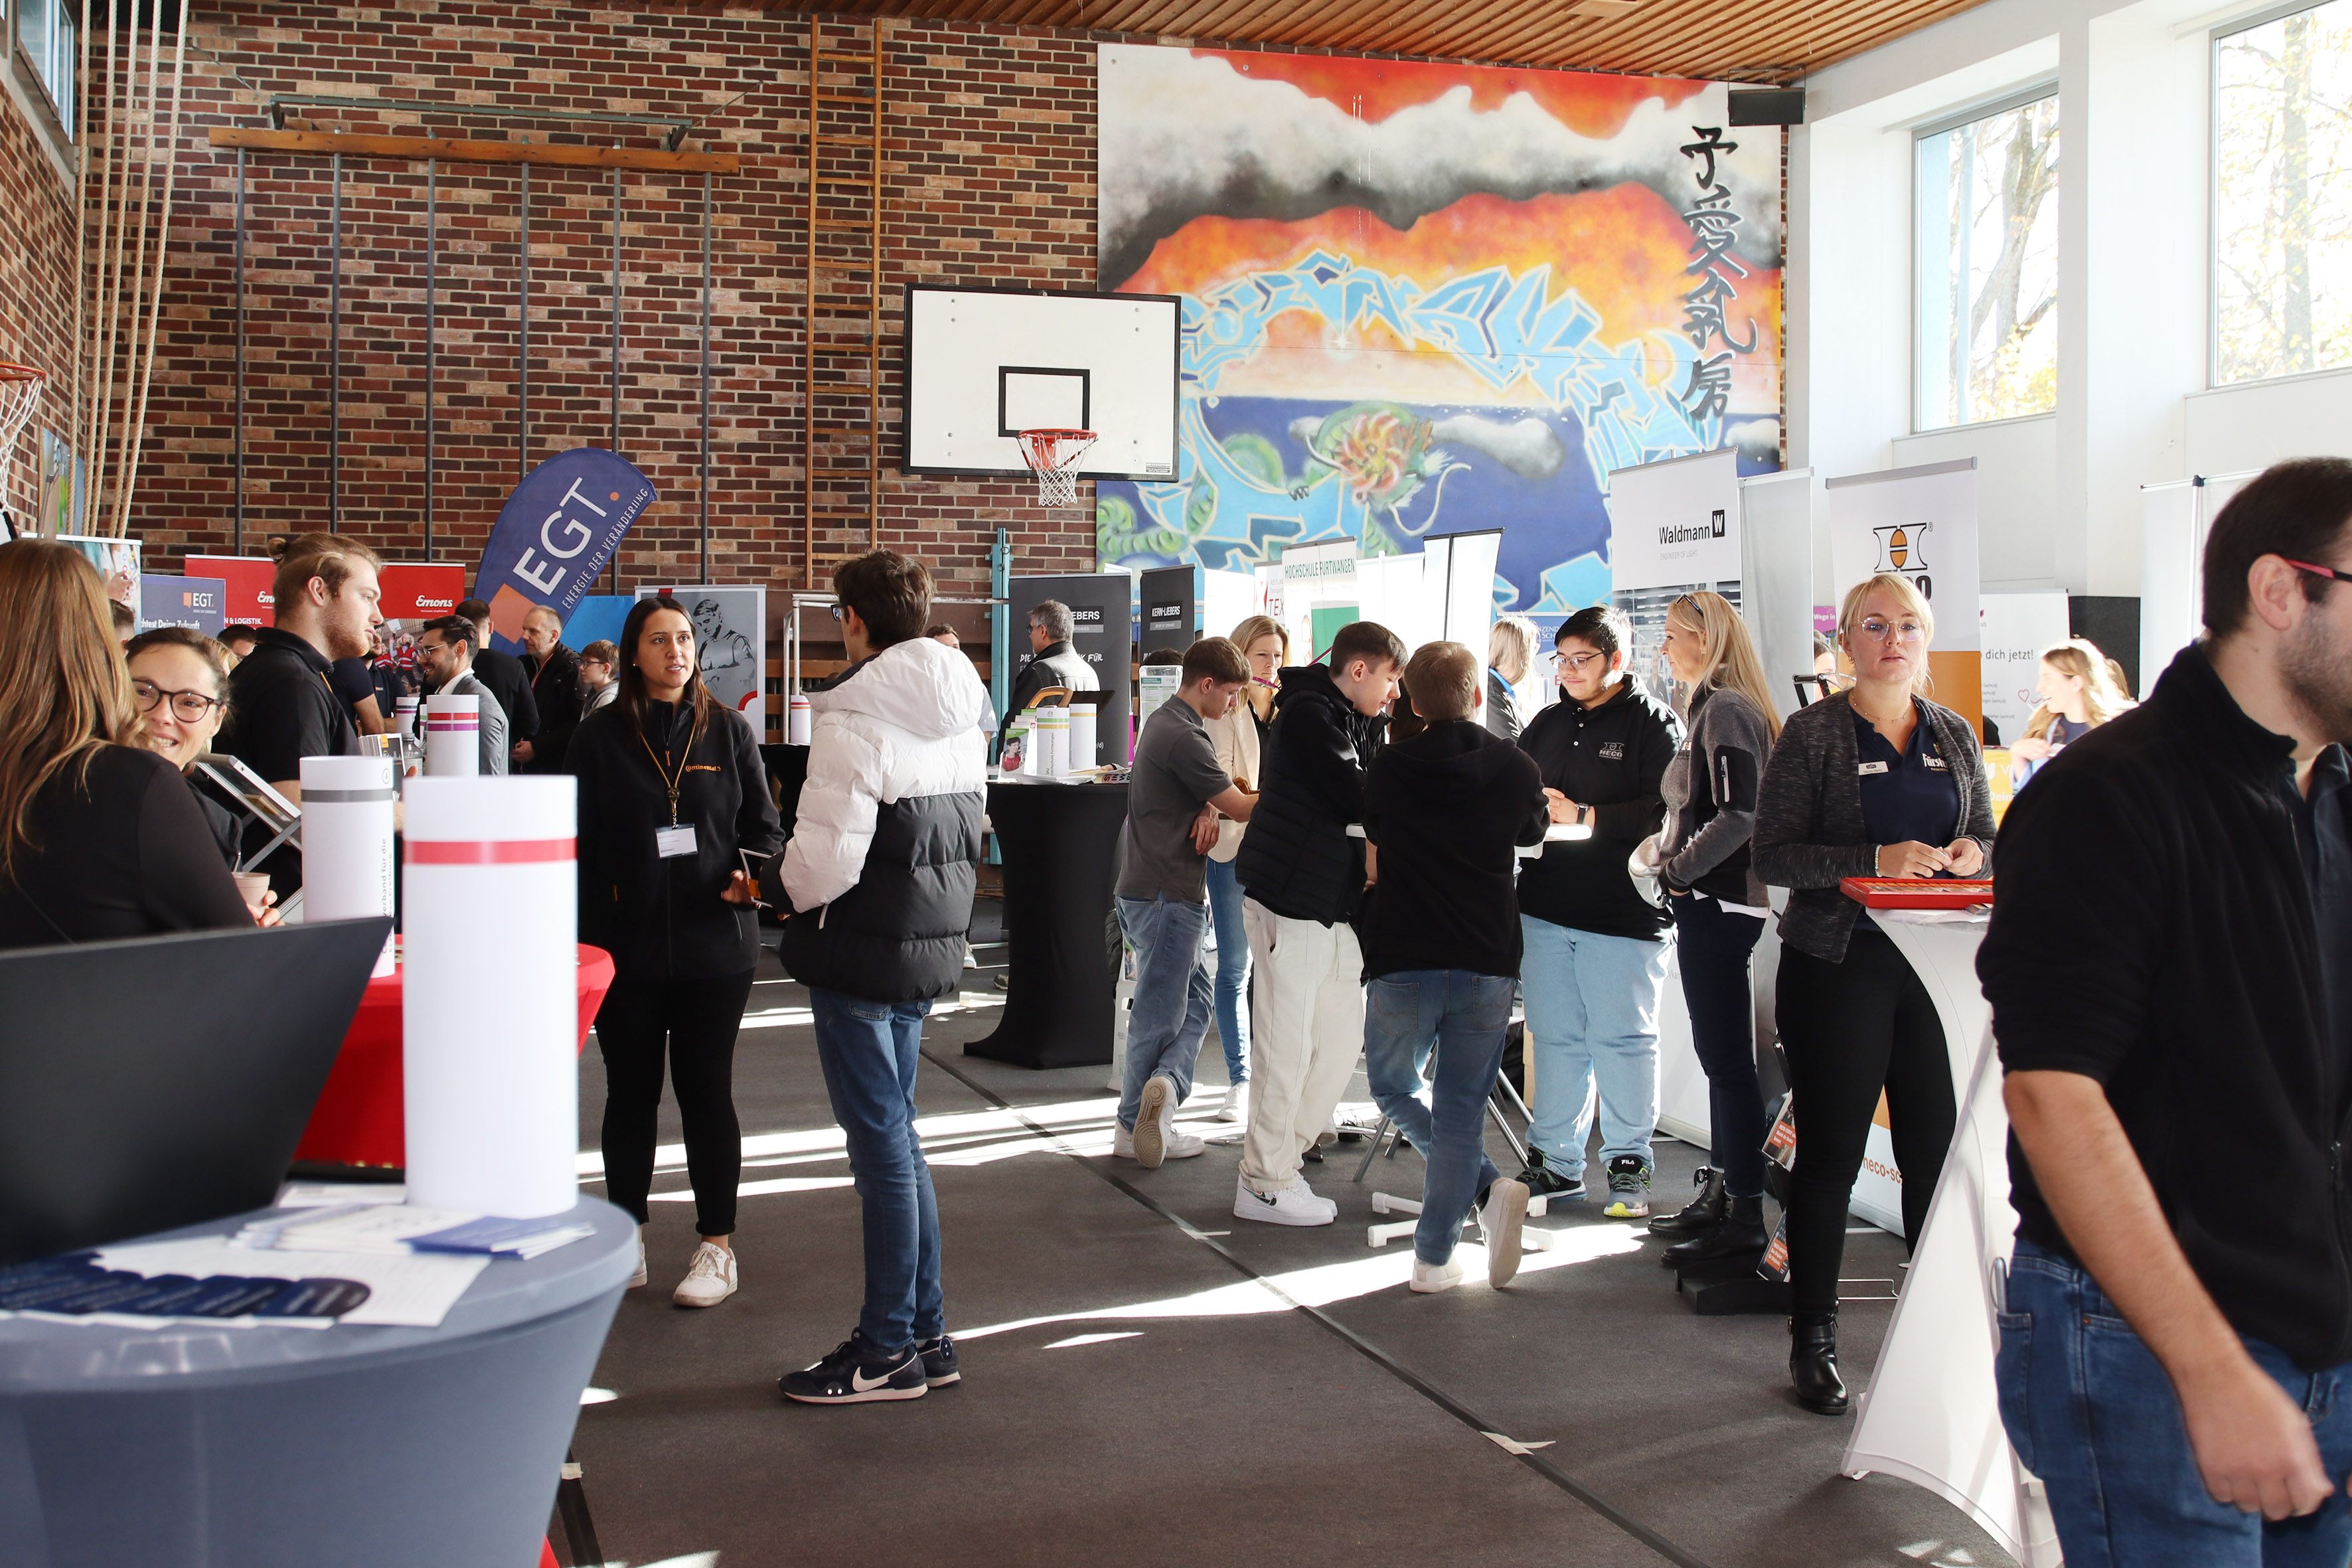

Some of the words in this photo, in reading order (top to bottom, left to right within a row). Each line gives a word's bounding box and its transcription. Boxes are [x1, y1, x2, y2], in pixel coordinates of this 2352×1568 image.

[1659, 524, 1710, 544] Waldmann
[1713, 514, 1724, 534] W
[1660, 552, 1680, 561] ENGINEER
[1285, 562, 1318, 579] HOCHSCHULE
[1319, 558, 1355, 576] FURTWANGEN
[562, 570, 592, 609] ENERGIE
[588, 552, 605, 571] DER
[257, 590, 275, 603] Em
[415, 595, 453, 607] Emons
[1071, 611, 1100, 620] EBERS
[1151, 605, 1181, 617] KERN-LIEBERS
[177, 619, 200, 630] Zukunft
[1020, 654, 1032, 663] DIE
[1087, 653, 1103, 663] FÜR
[1986, 649, 2005, 659] dich
[2008, 649, 2034, 663] jetzt!
[685, 763, 717, 772] Continental
[1990, 791, 2014, 802] Dein
